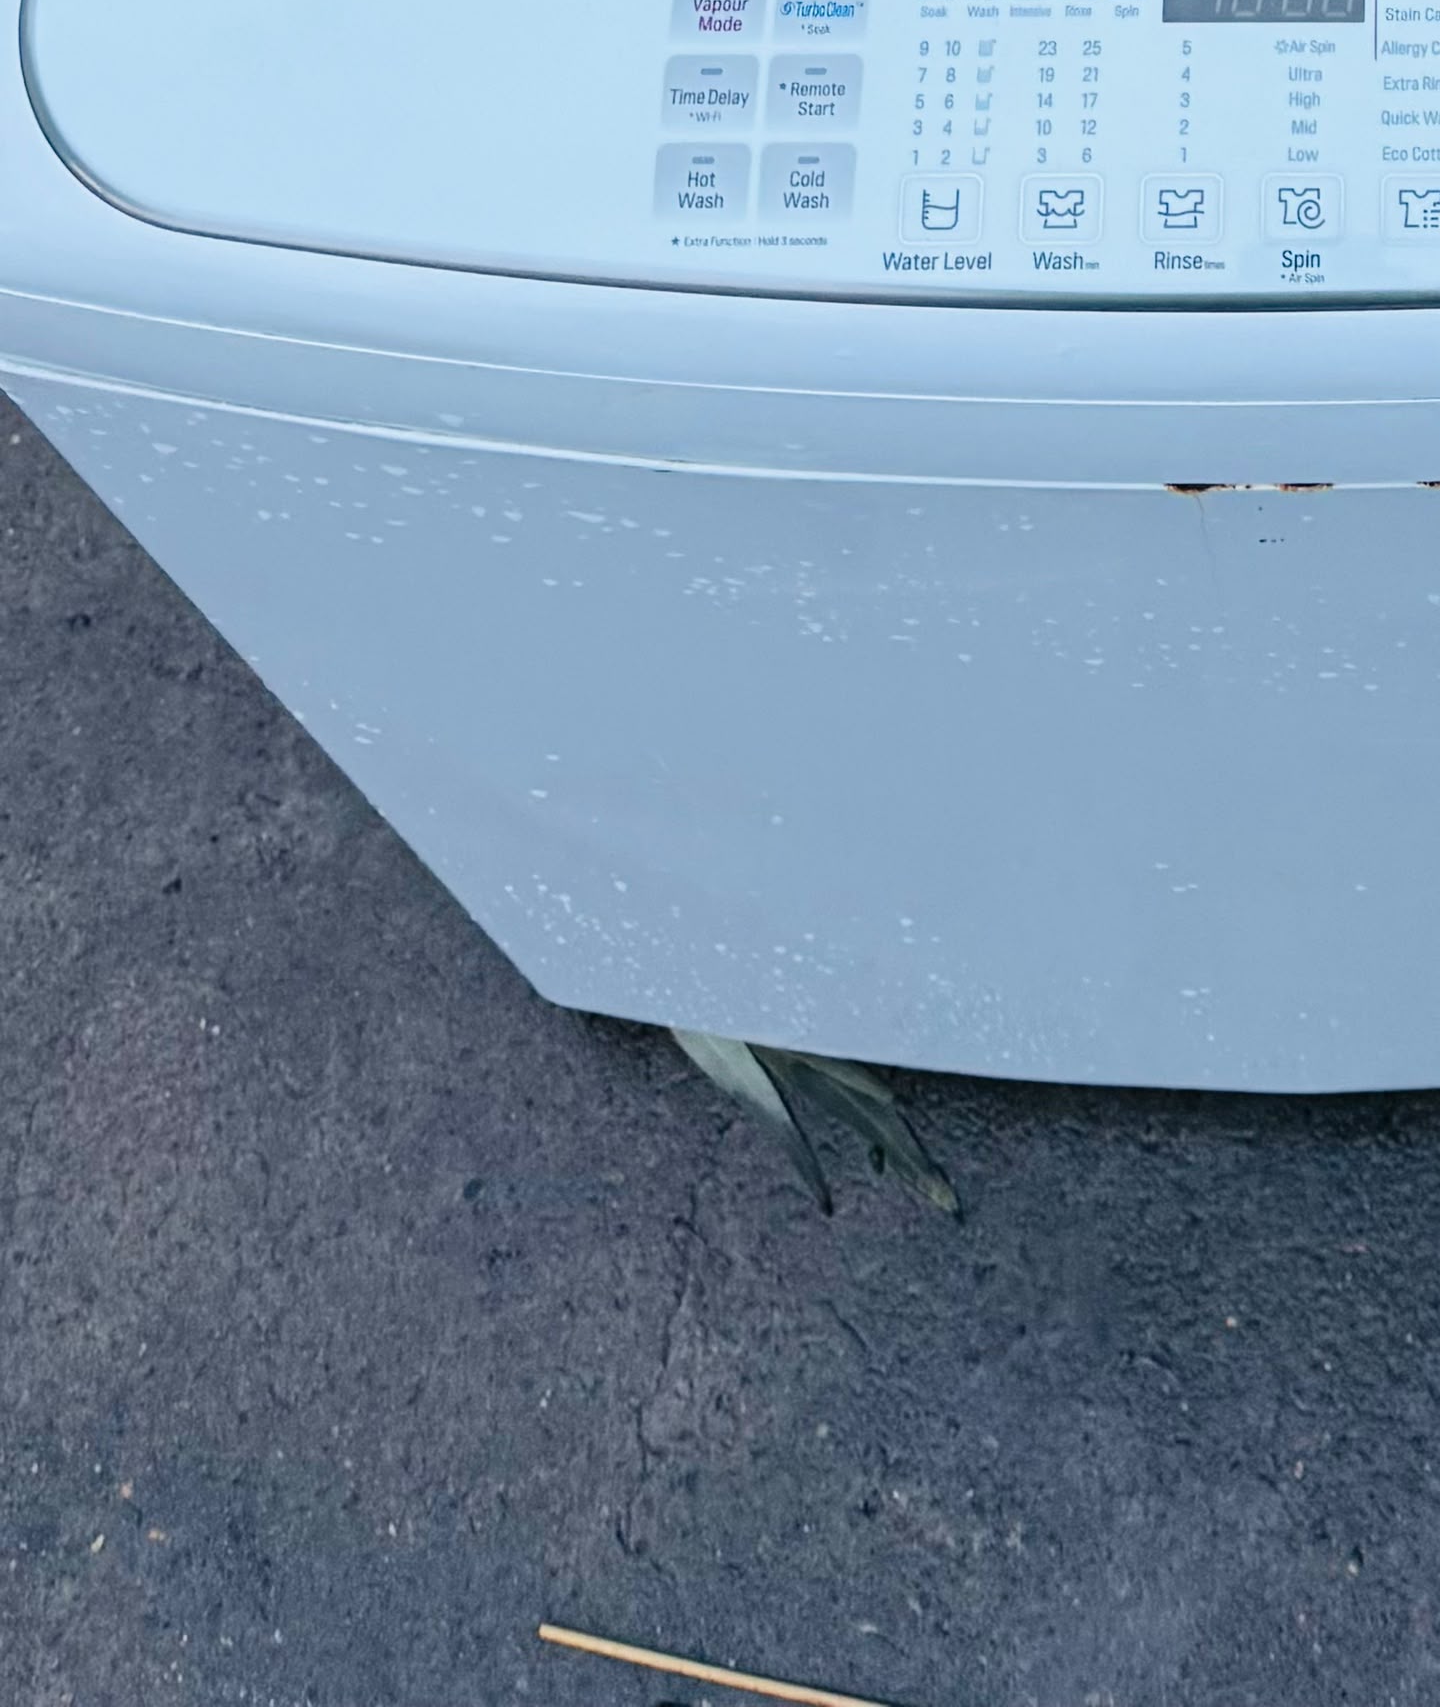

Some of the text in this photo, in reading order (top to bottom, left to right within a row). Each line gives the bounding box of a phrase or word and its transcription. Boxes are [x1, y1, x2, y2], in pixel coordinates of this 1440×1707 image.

[920, 5, 947, 18] Soak
[967, 5, 999, 18] Wash
[1114, 5, 1139, 19] Spin
[1385, 7, 1421, 22] Stain
[698, 16, 743, 32] Mode
[919, 40, 961, 56] 9 10
[1038, 40, 1102, 56] 23 25
[1181, 40, 1192, 56] 5
[1288, 39, 1336, 56] Air Spin
[1381, 40, 1429, 58] Allergy
[918, 67, 956, 84] 7 8
[1039, 67, 1099, 83] 19 21
[1181, 66, 1191, 82] 4
[1288, 66, 1323, 82] Ultra
[790, 82, 846, 97] Remote
[1383, 75, 1419, 91] Extra
[670, 88, 750, 108] Time Delay
[915, 93, 954, 109] 5 6
[1037, 92, 1098, 108] 14 17
[1180, 92, 1191, 108] 3
[1288, 91, 1321, 109] High
[798, 101, 836, 116] Start
[1381, 110, 1420, 126] Quick
[913, 120, 953, 136] 3 4
[1036, 119, 1097, 136] 10 12
[1179, 119, 1190, 136] 2
[1291, 119, 1317, 135] Mid
[912, 149, 951, 166] 1 2
[1036, 147, 1092, 164] 3 6
[1180, 147, 1188, 163] 1
[1287, 147, 1319, 162] Low
[1382, 145, 1408, 162] Eco
[687, 170, 716, 188] Hot
[789, 170, 826, 188] Cold
[677, 192, 724, 209] Wash
[783, 192, 830, 209] Wash
[882, 251, 992, 271] Water Level
[1032, 251, 1084, 270] Wash
[1154, 251, 1203, 270] Rinse
[1281, 249, 1321, 272] Spin
